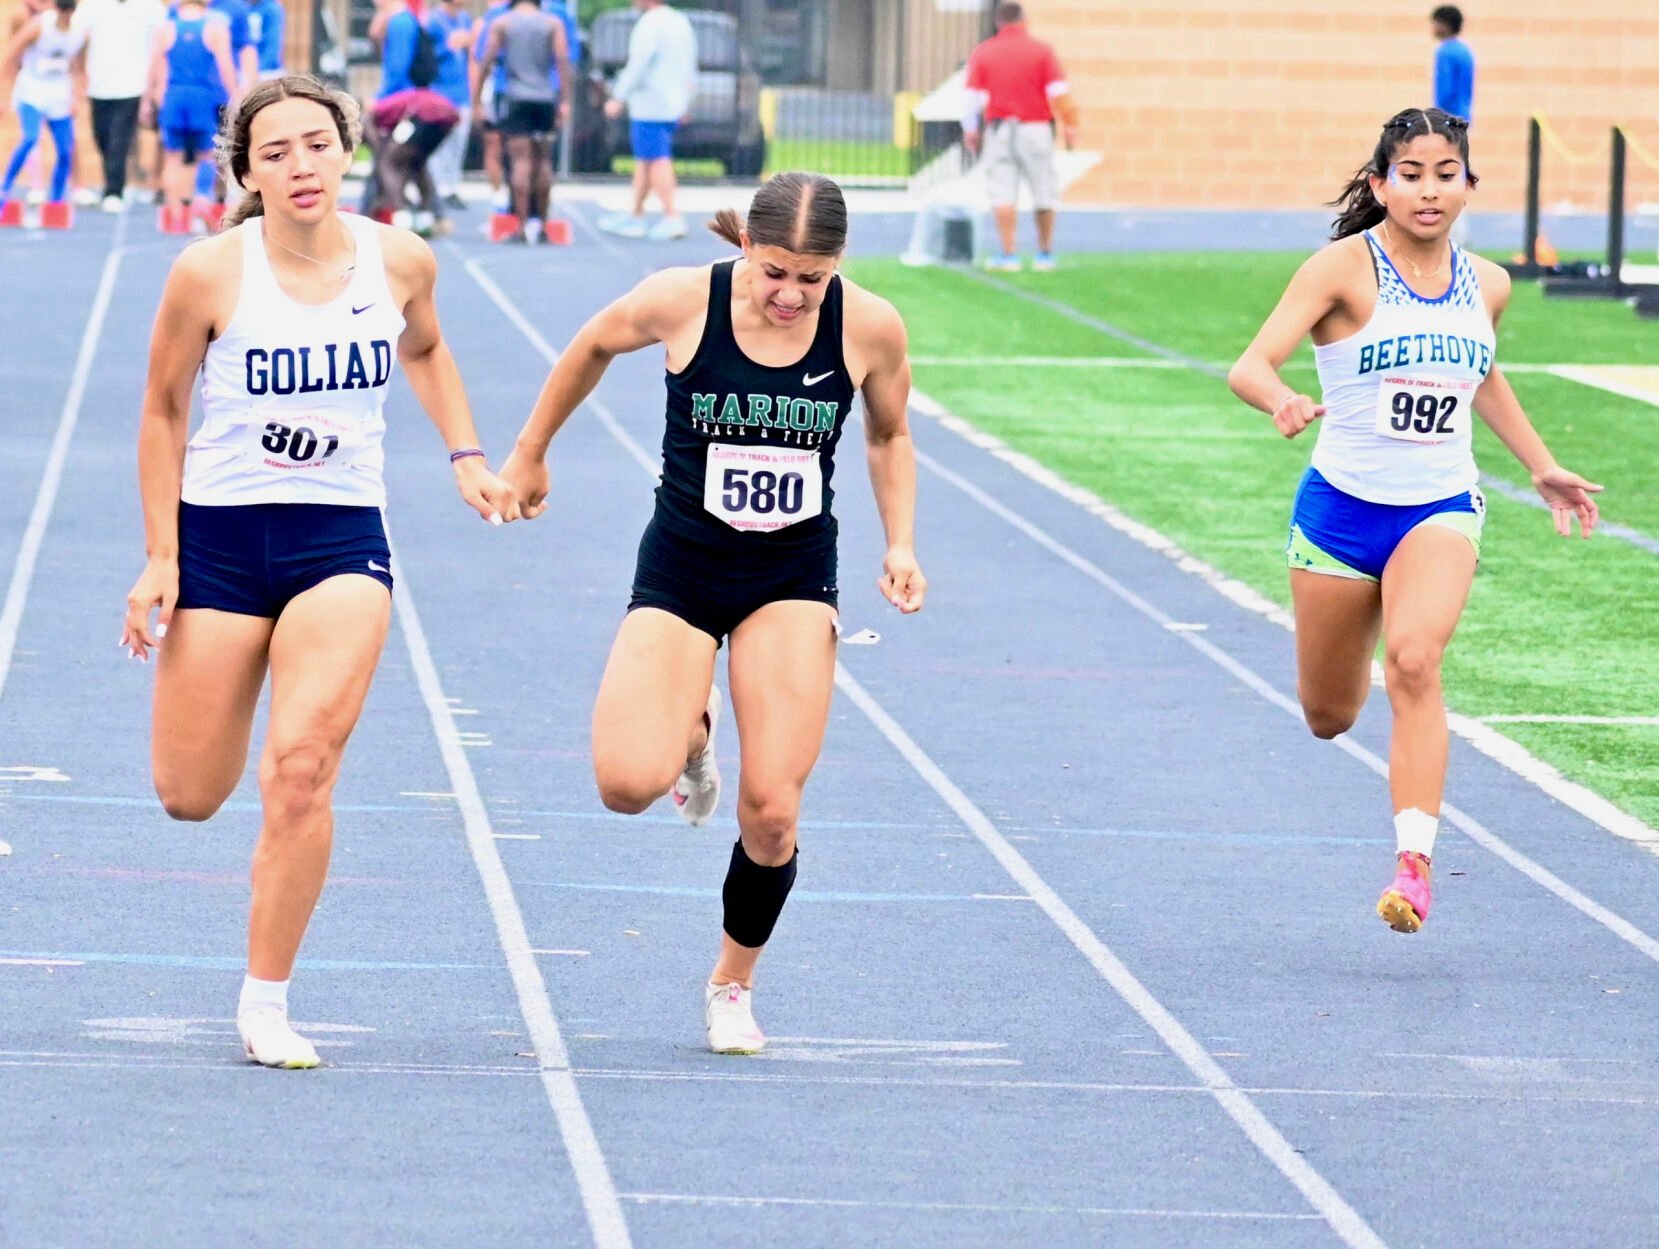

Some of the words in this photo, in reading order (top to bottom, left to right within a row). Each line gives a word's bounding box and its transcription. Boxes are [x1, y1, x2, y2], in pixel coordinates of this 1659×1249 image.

[245, 339, 391, 395] GOLIAD
[691, 392, 838, 432] MARION
[691, 417, 746, 436] TRACK
[1390, 391, 1458, 434] 992
[261, 421, 339, 462] 301
[721, 468, 804, 515] 580
